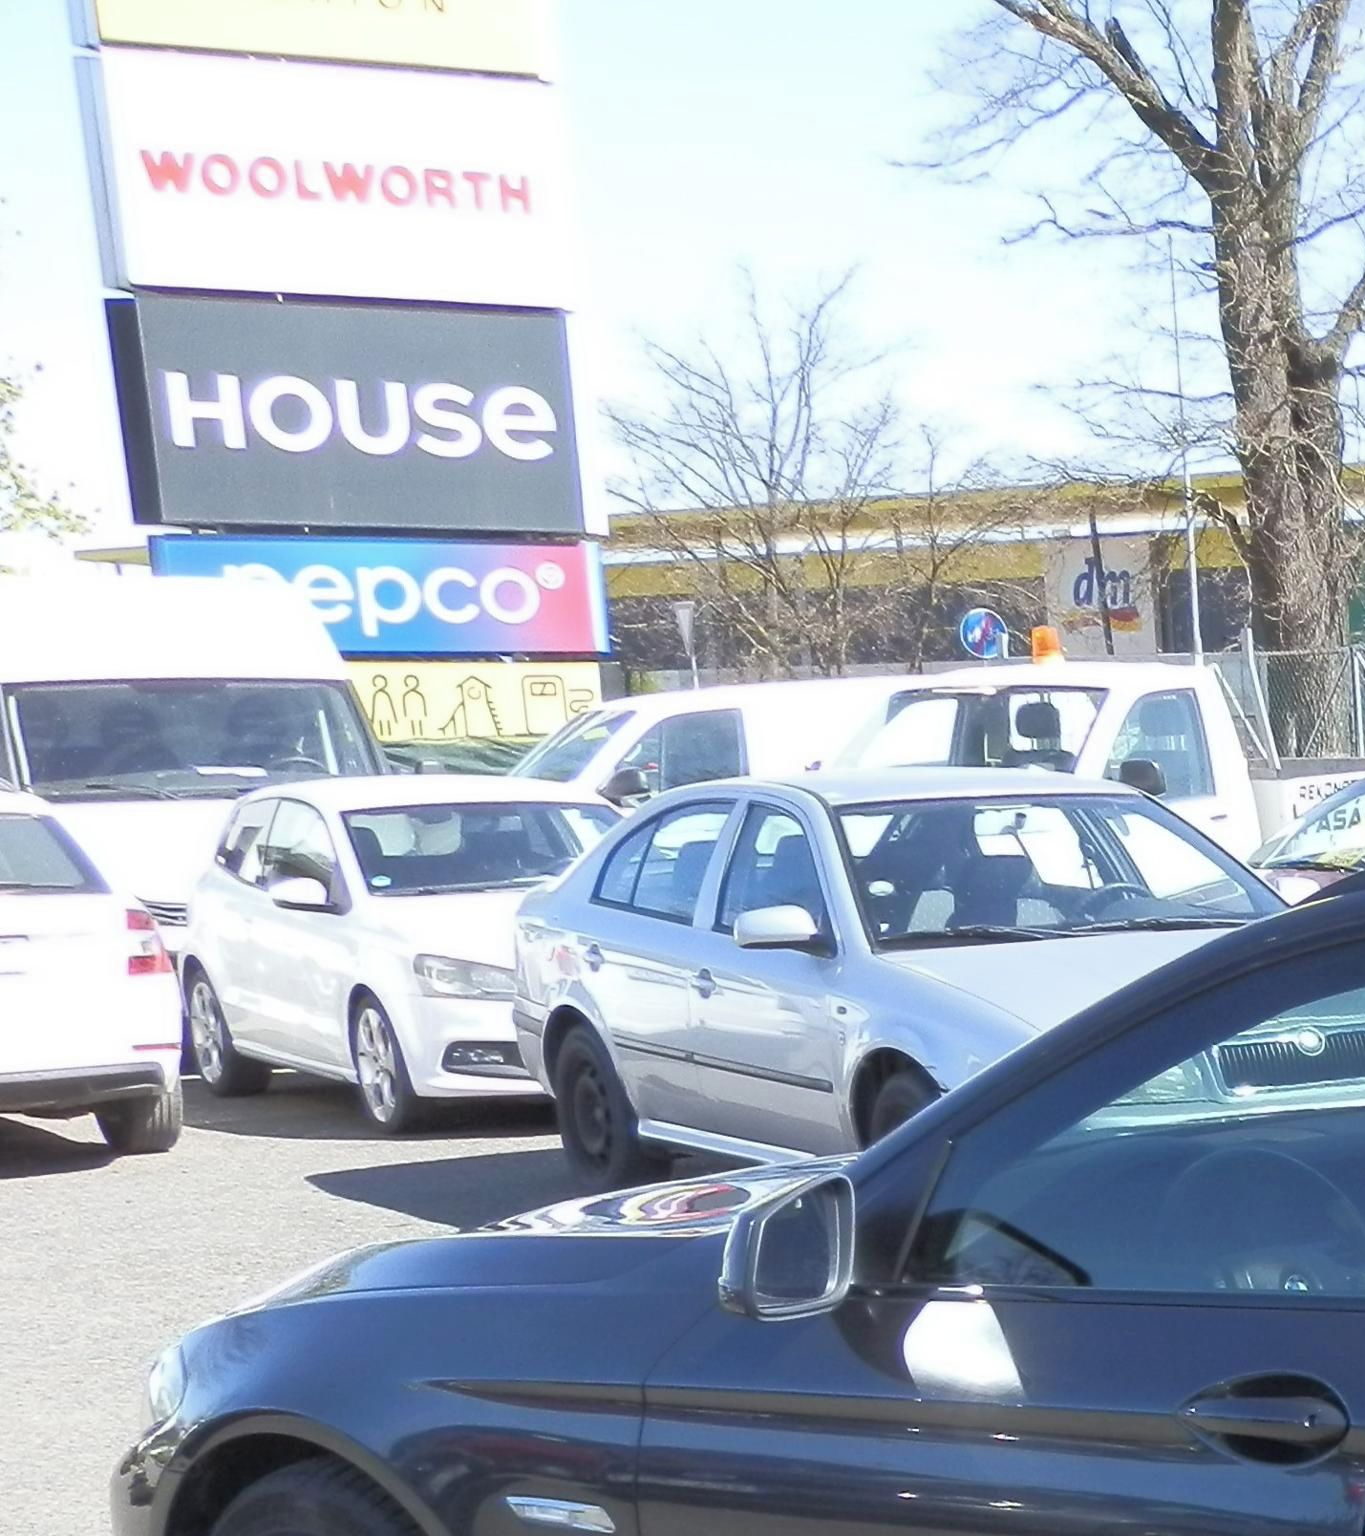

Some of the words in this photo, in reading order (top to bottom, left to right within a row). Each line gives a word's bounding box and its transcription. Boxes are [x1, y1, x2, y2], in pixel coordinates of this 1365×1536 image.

[139, 149, 532, 214] WOOLWORTH
[223, 563, 541, 637] epco
[1073, 556, 1131, 607] dm
